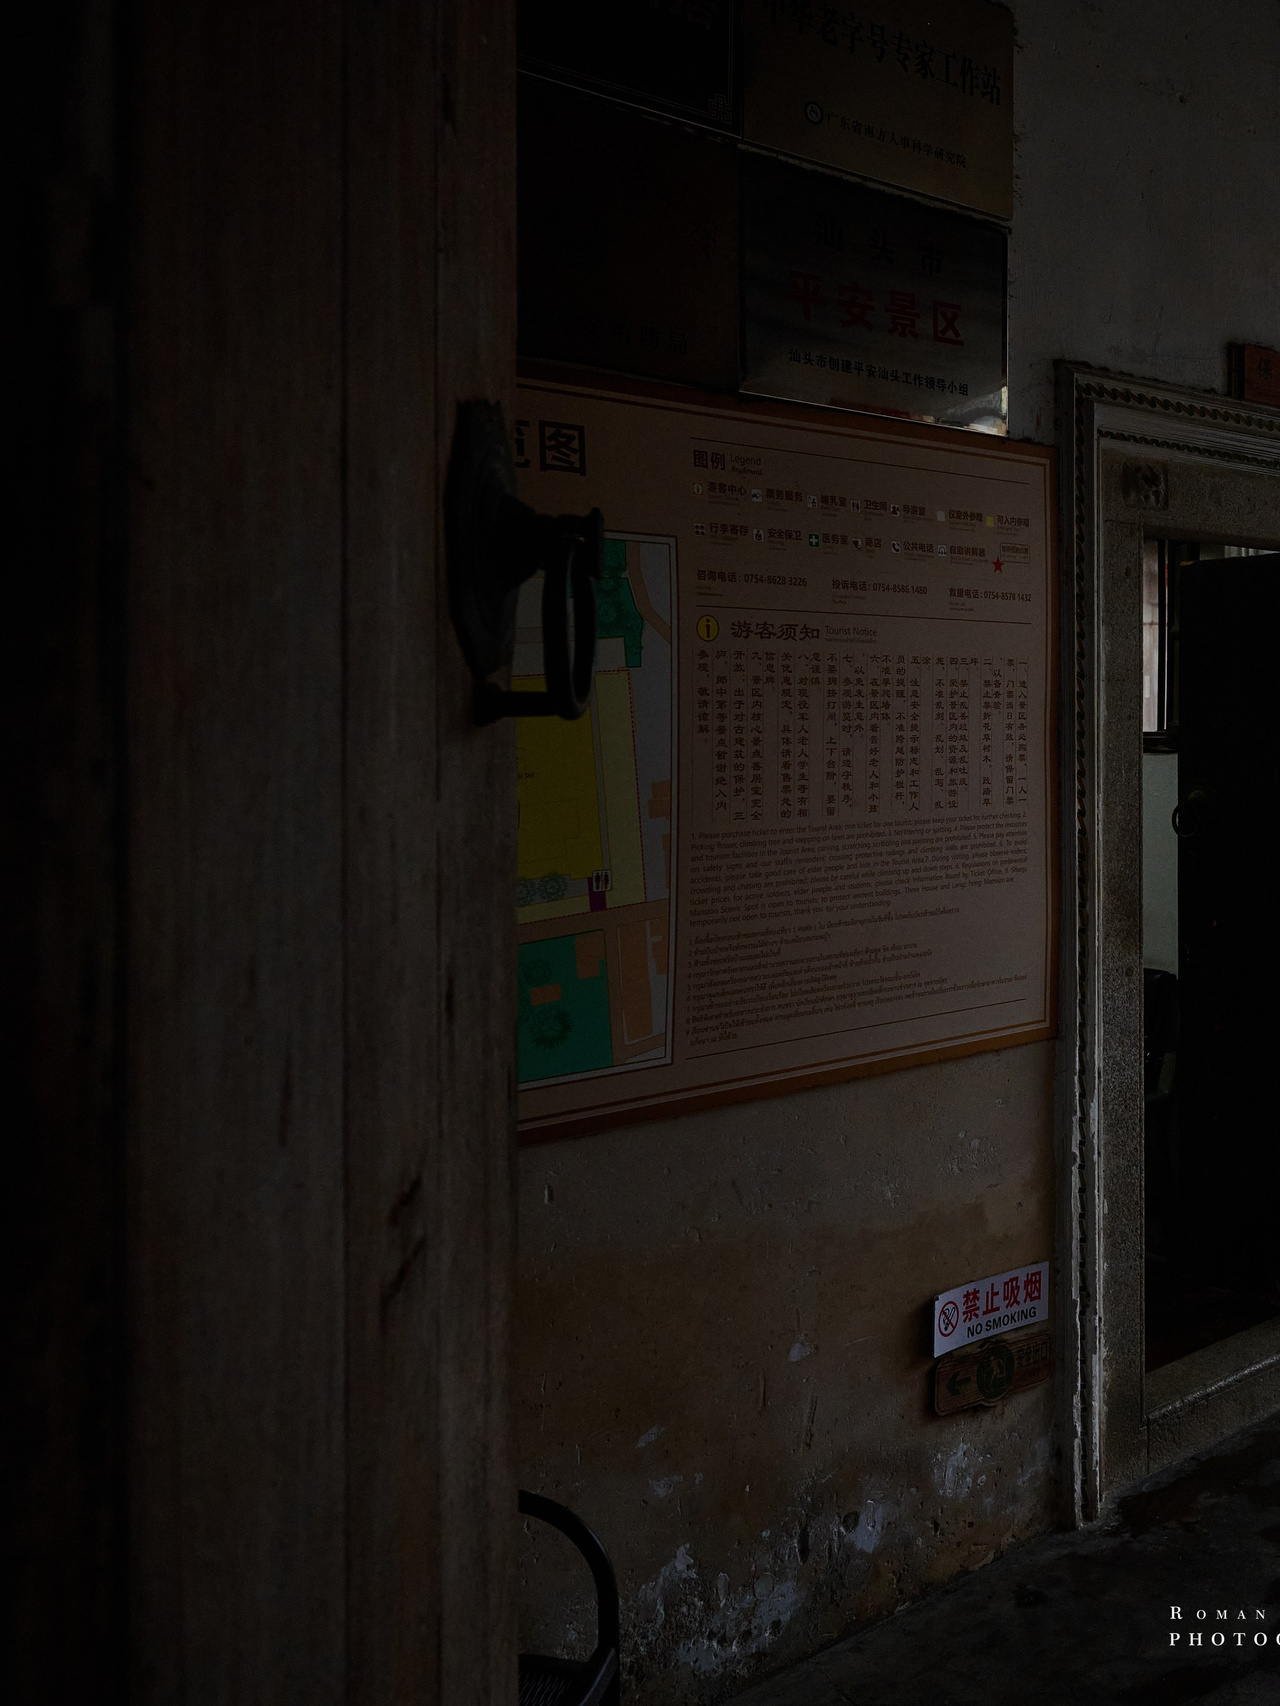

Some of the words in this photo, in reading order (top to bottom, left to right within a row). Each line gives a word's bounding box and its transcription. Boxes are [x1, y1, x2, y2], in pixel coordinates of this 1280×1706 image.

[786, 270, 964, 346] 平安景区
[789, 347, 969, 396] 汕头市创建平安汕头工作领导小组
[693, 449, 725, 470] 图例
[730, 453, 760, 468] Legend
[708, 481, 746, 496] 游客中心
[864, 499, 886, 511] 卫生间
[709, 522, 748, 536] 行李寄存
[767, 527, 801, 541] 安全保卫
[822, 532, 848, 545] 医务室
[865, 536, 881, 548] 商店
[903, 541, 933, 553] 公共电话
[730, 620, 820, 642] 游客须知
[825, 625, 850, 636] Tourist
[853, 626, 877, 637] Notice
[962, 1271, 1042, 1323] 禁止吸烟
[967, 1322, 982, 1338] NO
[985, 1307, 1037, 1332] SMOKING
